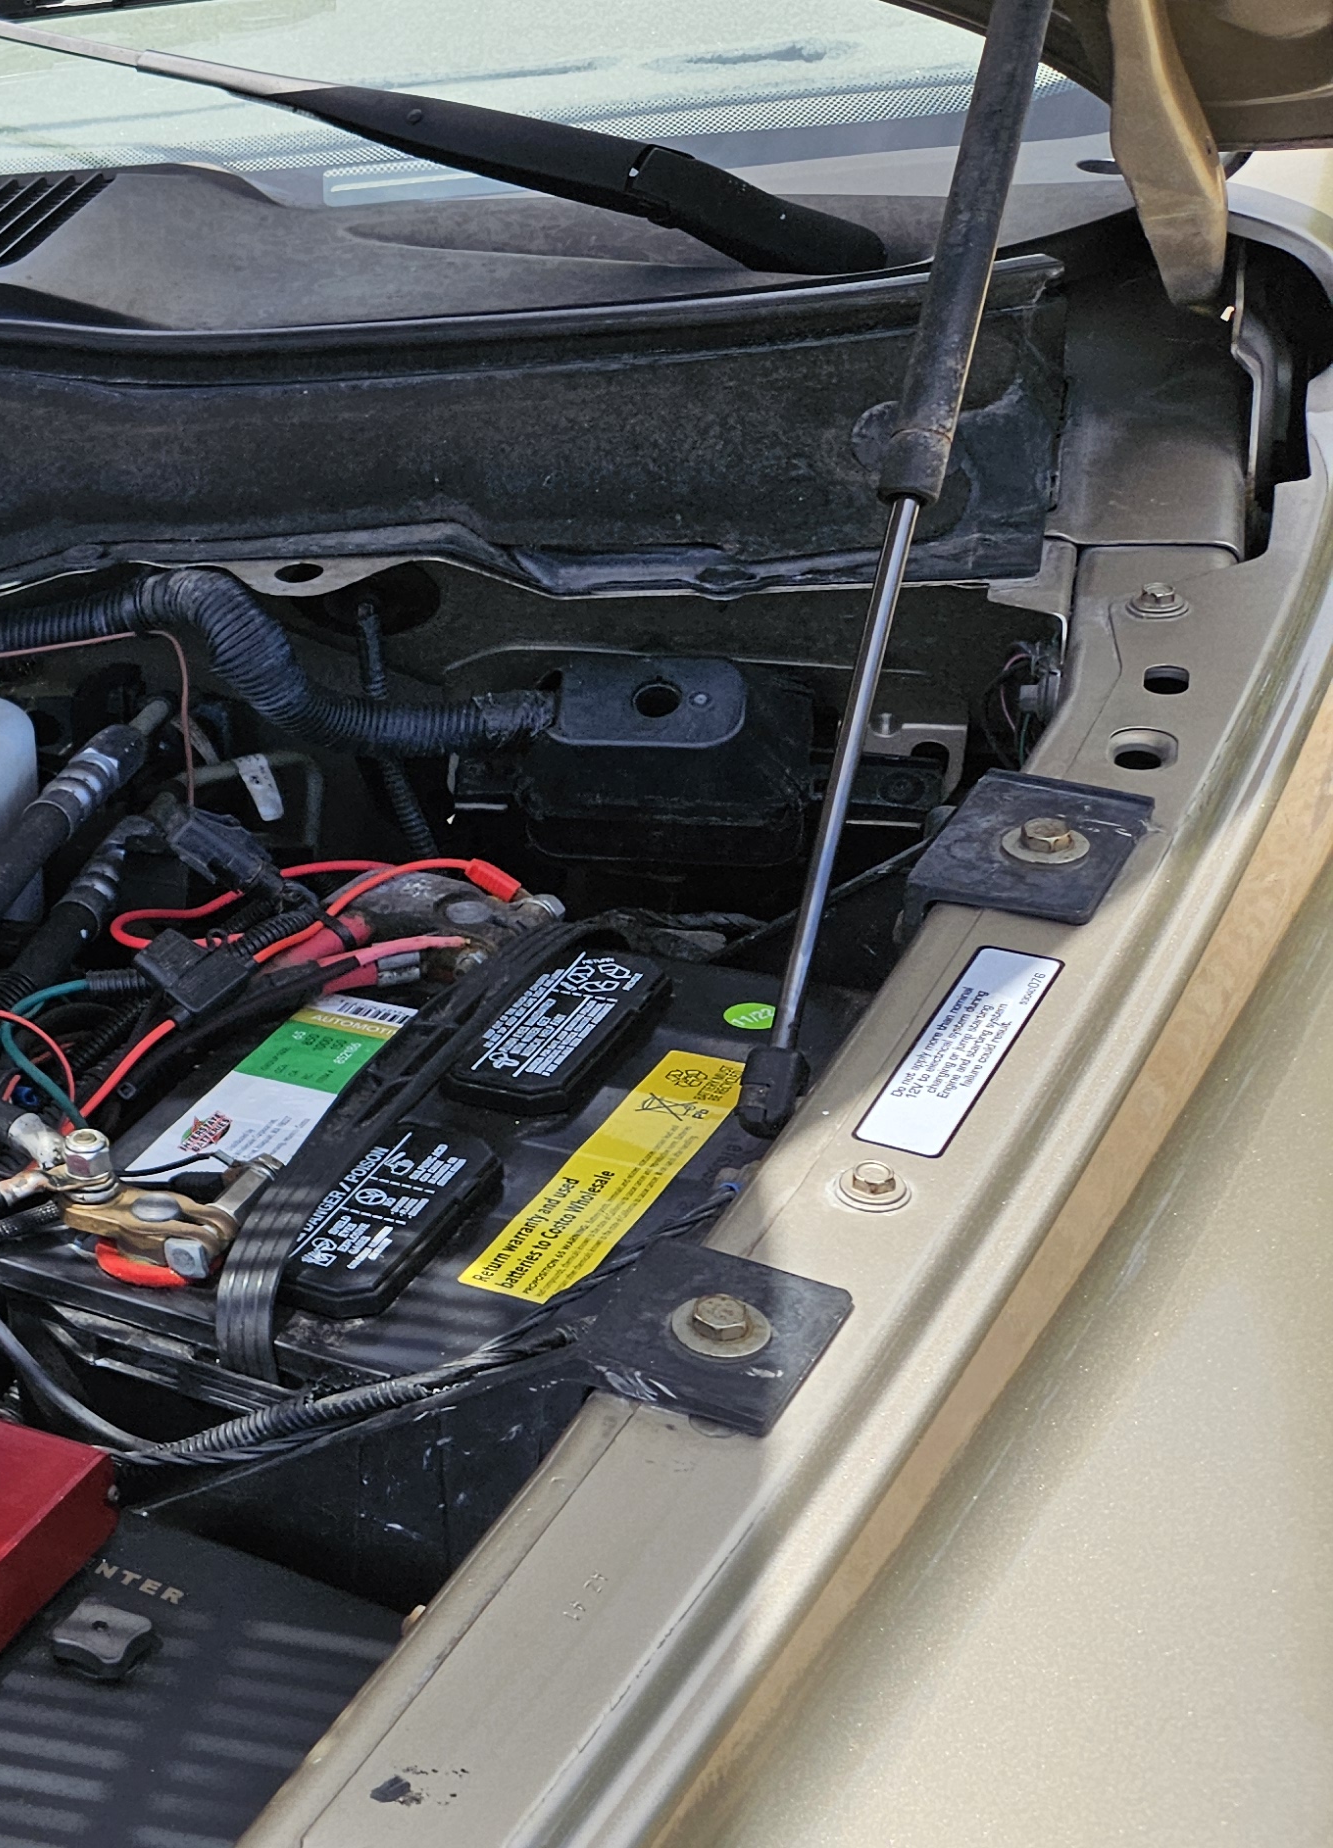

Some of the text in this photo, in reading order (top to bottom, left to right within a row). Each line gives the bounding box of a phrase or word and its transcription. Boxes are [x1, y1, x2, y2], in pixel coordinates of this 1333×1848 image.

[312, 1014, 396, 1036] AUTOMOTI
[731, 1008, 775, 1026] 11/22
[890, 986, 973, 1097] Do not apply more than nominal
[905, 990, 988, 1097] 12V to electrical system during
[927, 1004, 993, 1093] charging or jump starting
[936, 1003, 1007, 1098] Engine and starting system
[960, 1064, 982, 1087] failure
[977, 1043, 996, 1063] could
[692, 1109, 709, 1119] Pb
[304, 1189, 345, 1232] DANGER
[344, 1146, 390, 1184] POISON
[472, 1177, 579, 1281] Return warranty and used
[496, 1170, 614, 1288] batteries to Costco Wholesale
[522, 1258, 558, 1293] PROPOSITION
[554, 1250, 566, 1258] 65
[94, 1562, 185, 1605] NTER
